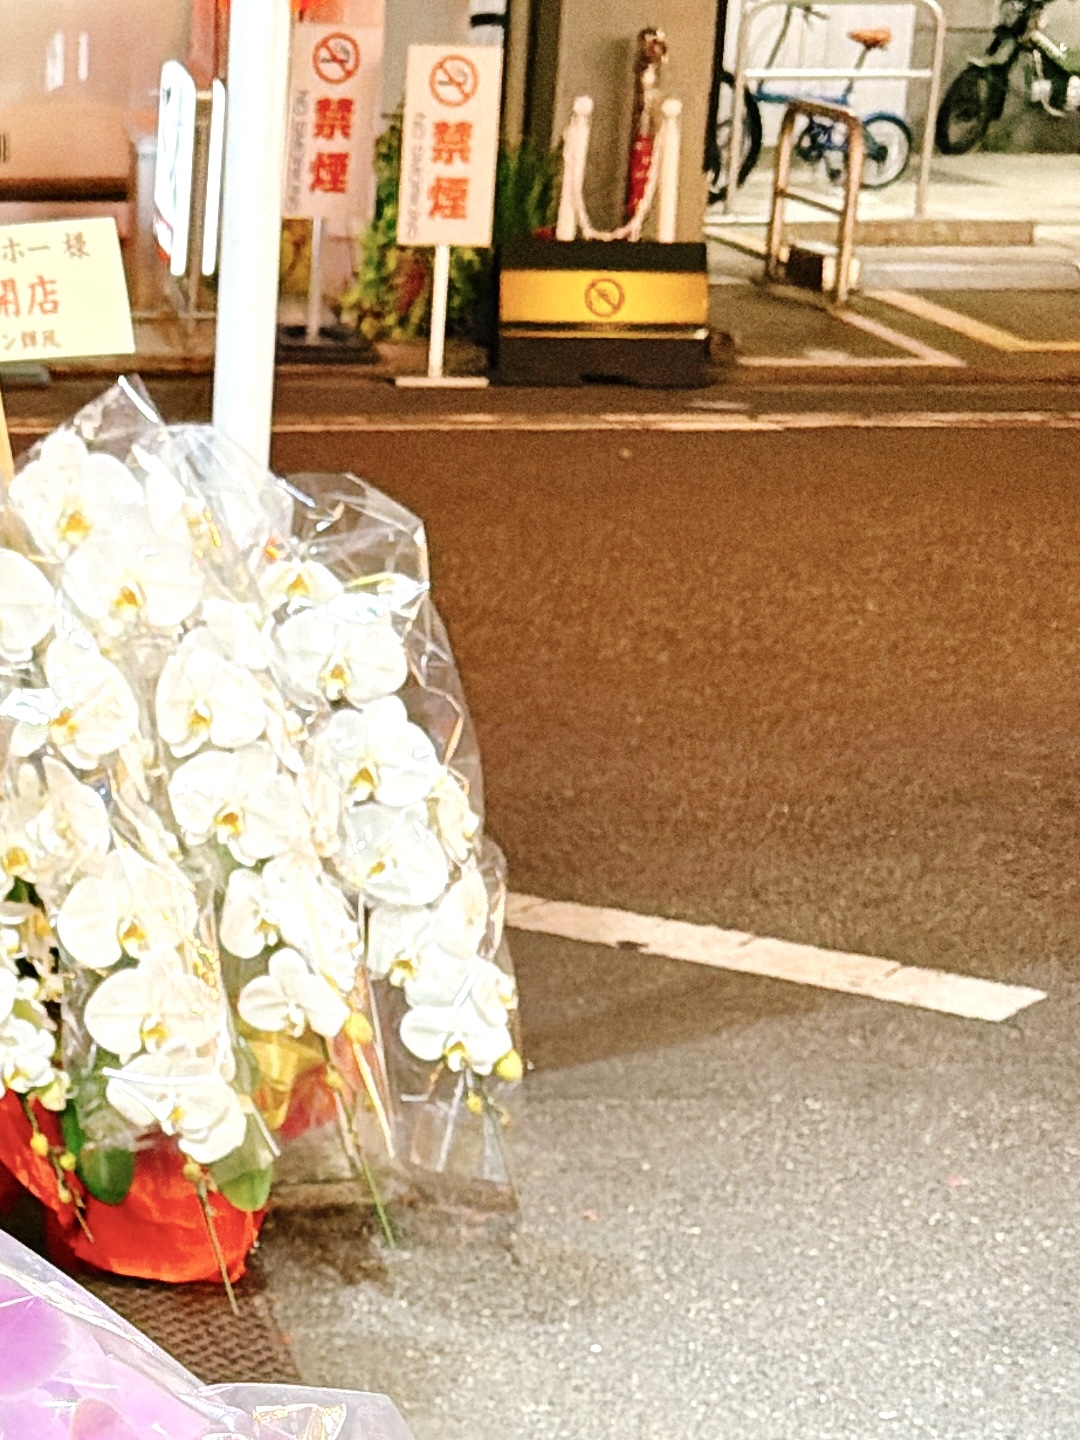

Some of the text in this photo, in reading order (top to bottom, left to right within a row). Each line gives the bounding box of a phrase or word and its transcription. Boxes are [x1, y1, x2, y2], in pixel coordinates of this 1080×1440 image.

[310, 97, 353, 194] 禁煙
[428, 120, 472, 220] 禁煙
[62, 231, 91, 260] 様
